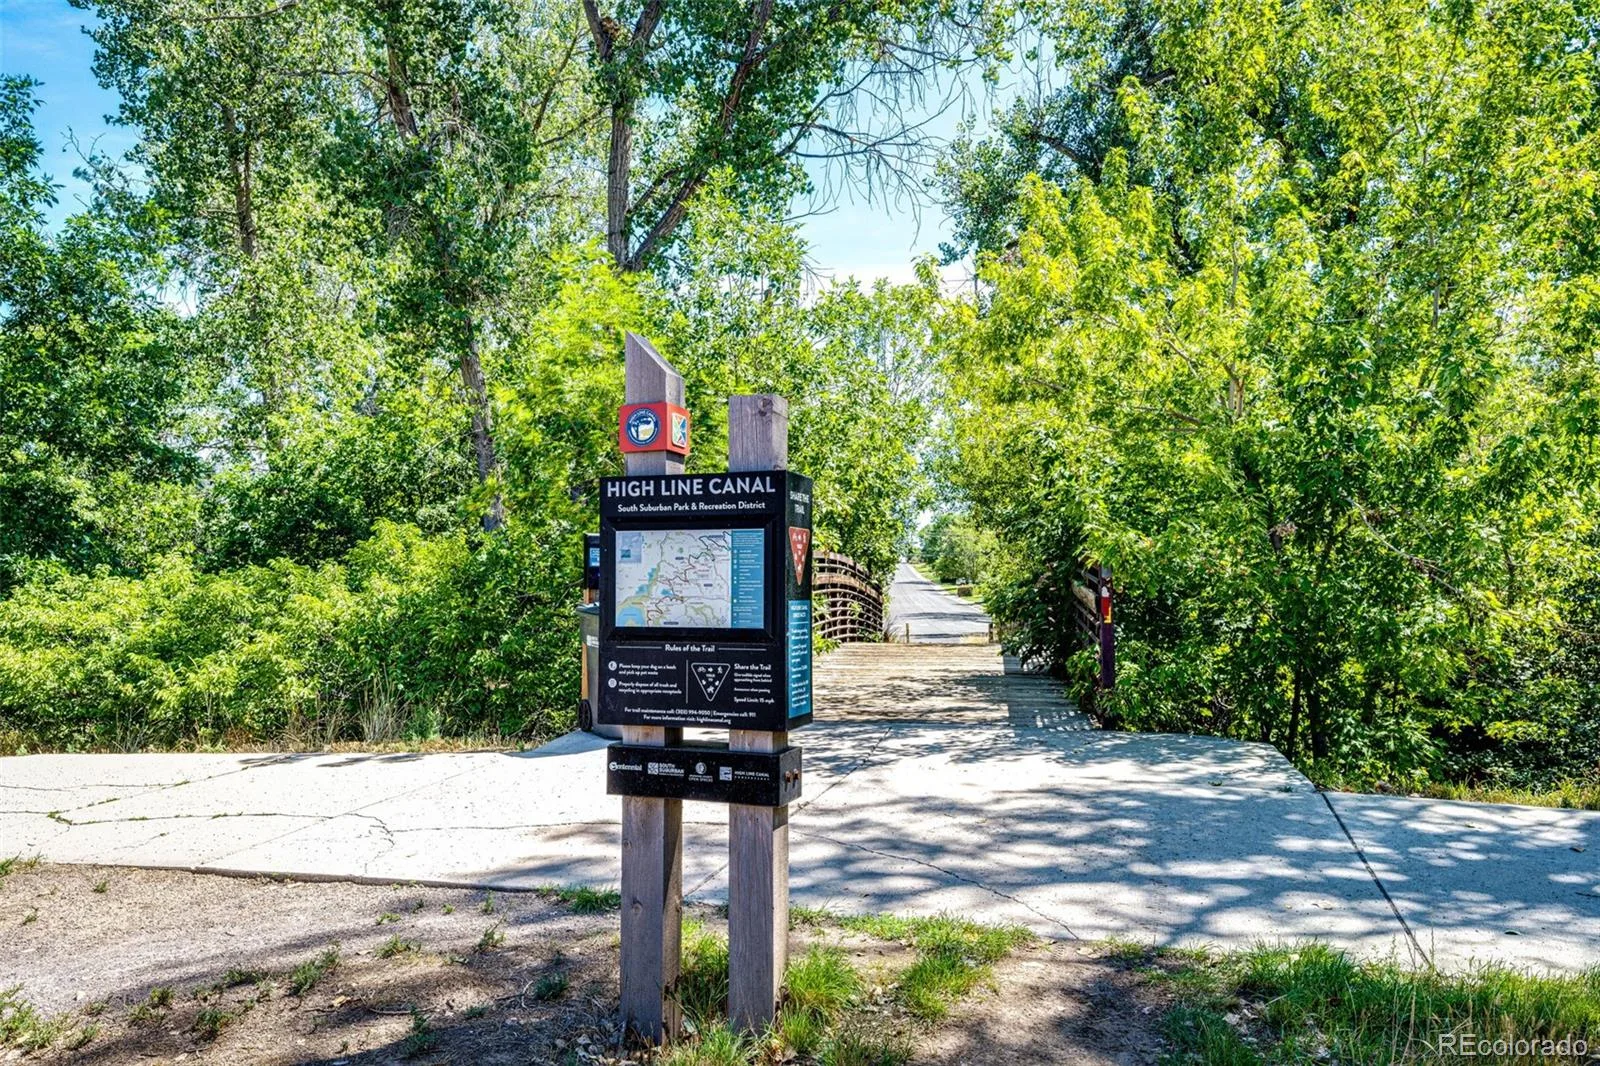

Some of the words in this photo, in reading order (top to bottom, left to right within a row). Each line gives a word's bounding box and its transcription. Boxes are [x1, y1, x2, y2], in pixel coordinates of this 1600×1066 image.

[607, 480, 655, 498] HIGH
[661, 478, 704, 496] LINE
[708, 476, 776, 495] CANAL
[617, 503, 639, 513] South
[639, 502, 673, 512] Suburban
[673, 501, 690, 511] Park
[691, 501, 698, 511] &
[698, 501, 737, 511] Recreation
[738, 500, 766, 510] District
[664, 643, 682, 652] Rules
[682, 644, 690, 652] of
[690, 644, 701, 652] the
[701, 644, 716, 653] Trail
[631, 663, 641, 671] keep
[650, 663, 658, 671] dog
[734, 663, 749, 671] Share
[750, 663, 759, 671] the
[759, 663, 772, 671] Trail
[619, 680, 635, 688] Properly
[659, 681, 669, 689] trash
[734, 696, 747, 704] Speed
[764, 697, 775, 705] mph
[713, 710, 740, 718] Emergencies
[609, 761, 642, 771] Centennial
